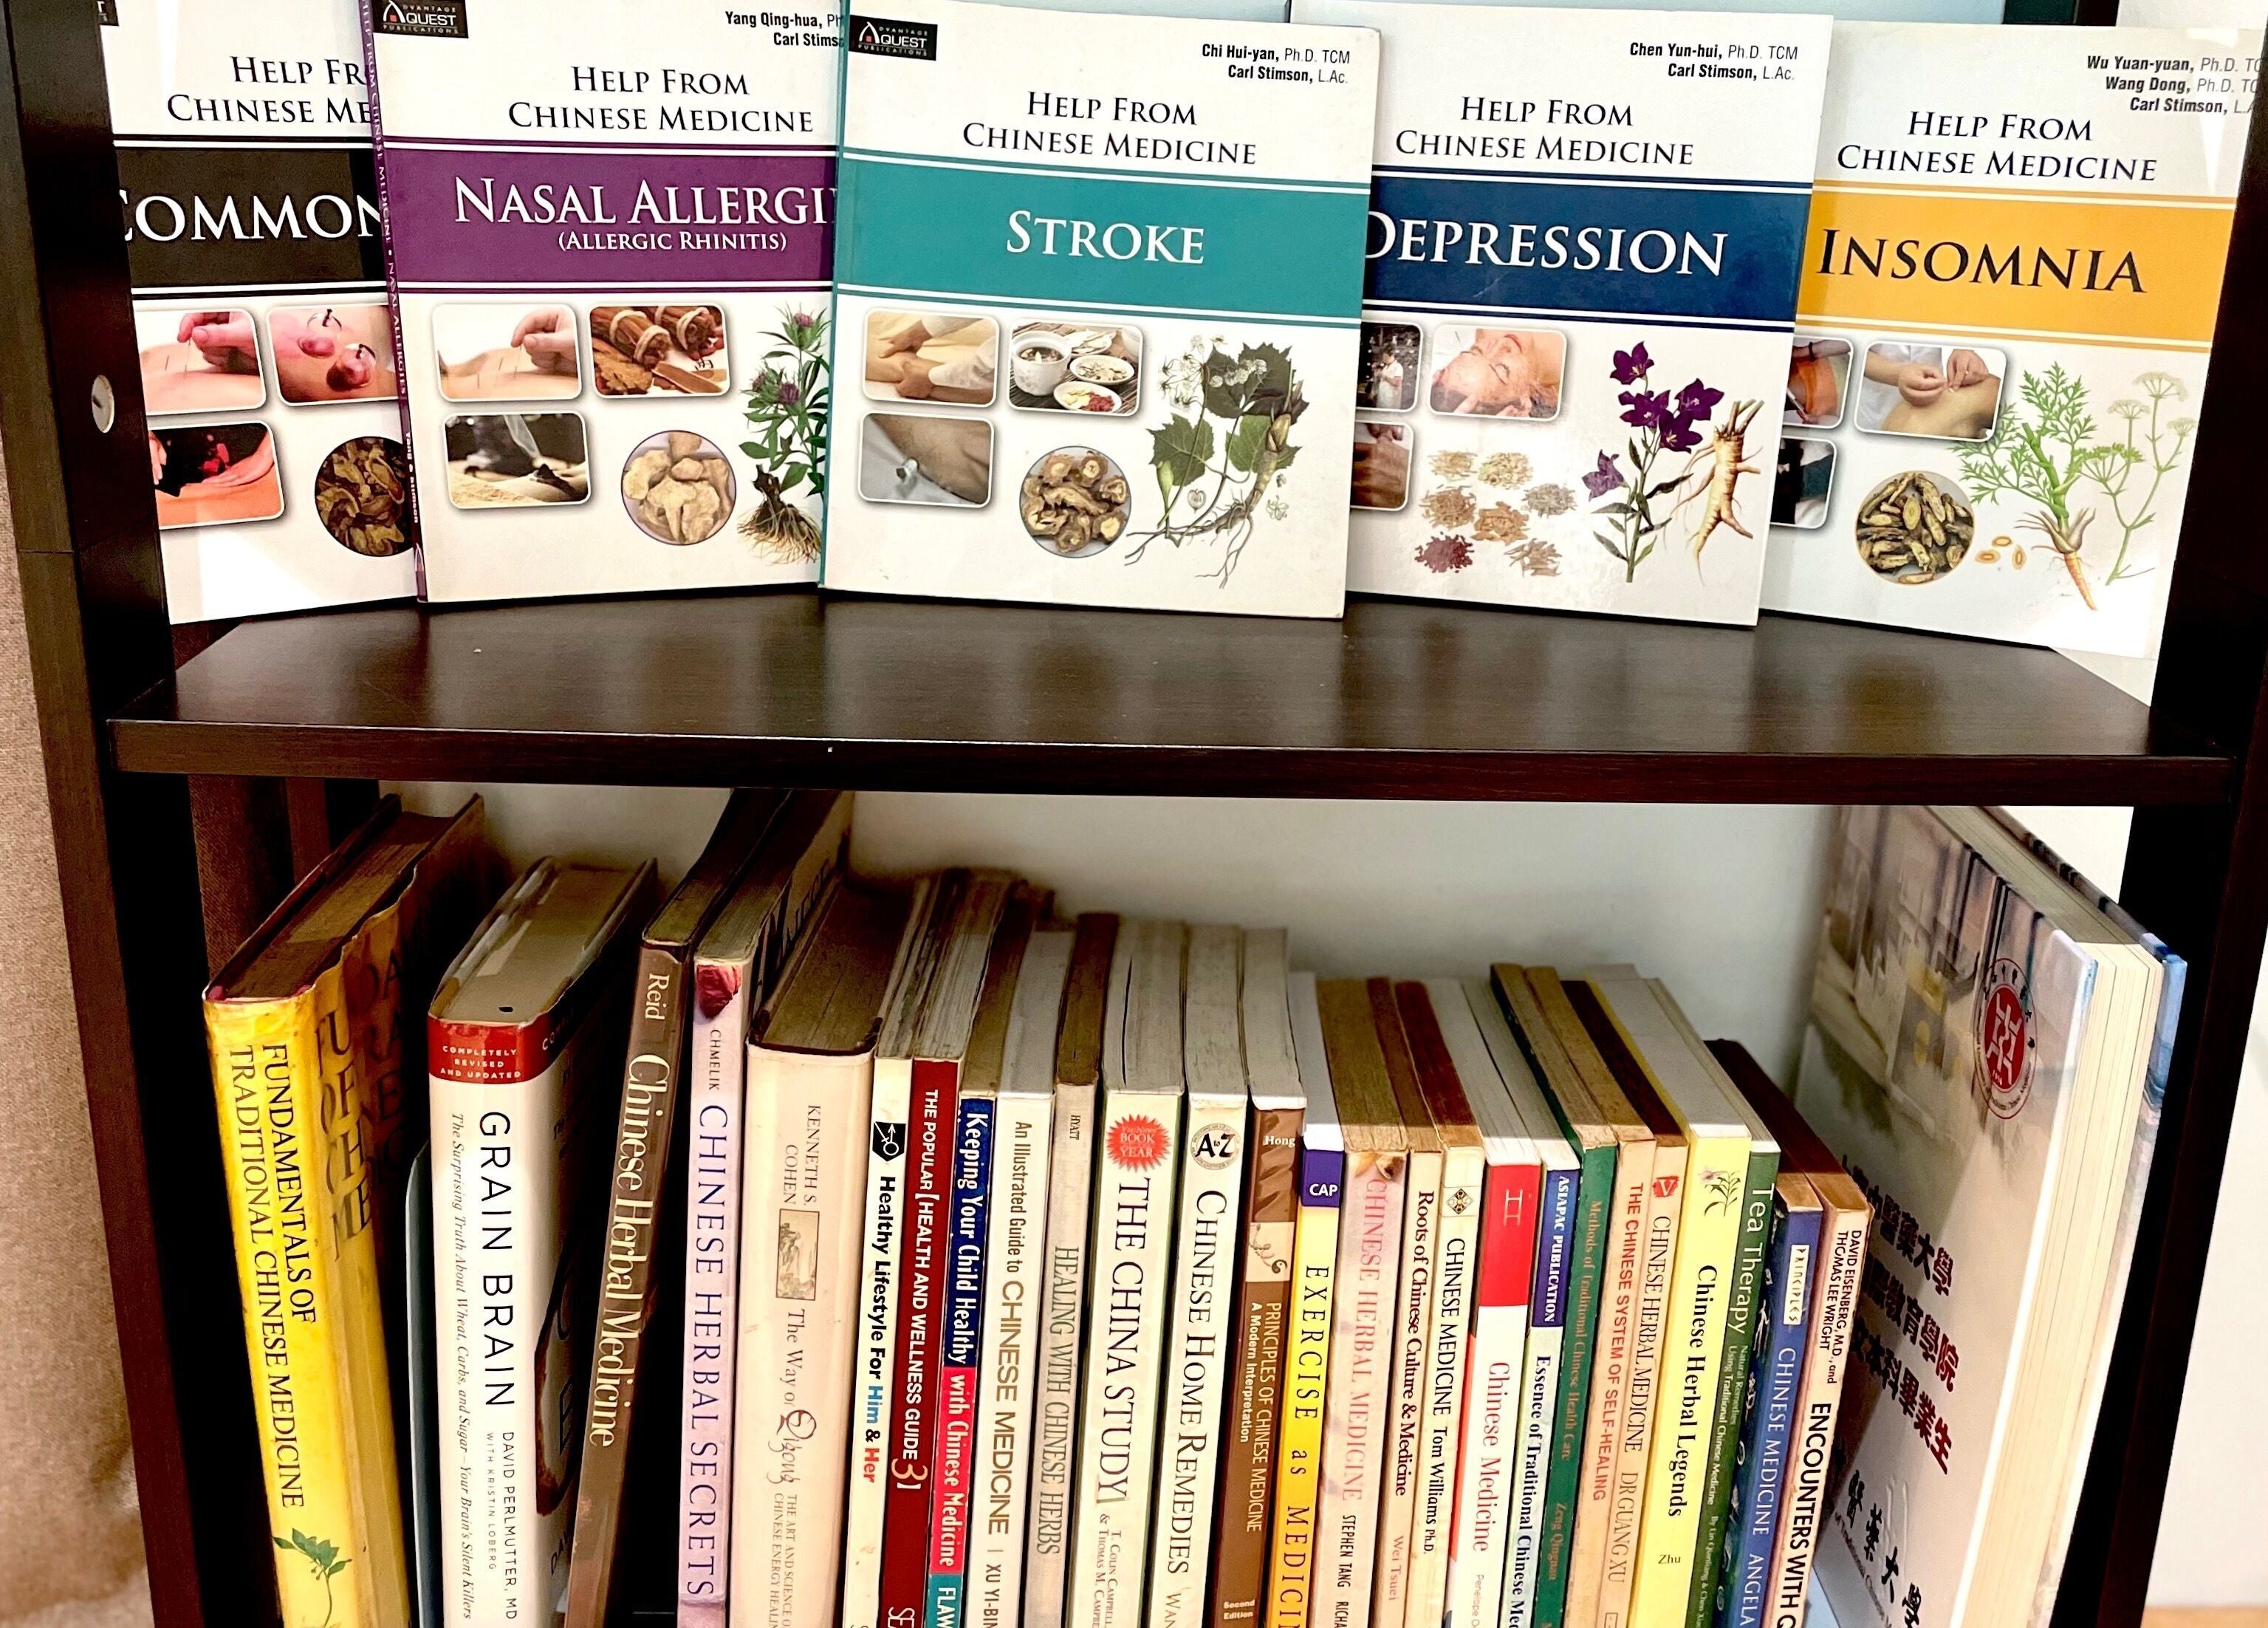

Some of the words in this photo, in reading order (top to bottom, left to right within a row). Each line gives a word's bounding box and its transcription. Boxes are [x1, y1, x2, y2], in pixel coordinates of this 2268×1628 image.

[405, 13, 456, 26] QUEST
[880, 34, 927, 48] QUEST
[570, 66, 651, 94] HELP
[661, 69, 750, 95] FROM
[1202, 44, 1222, 58] Chi
[1227, 45, 1279, 63] Hui-yan,
[1284, 47, 1318, 63] Ph.D.
[1322, 49, 1350, 64] TCM
[1228, 65, 1254, 79] Carl
[1258, 66, 1312, 84] Stimson,
[1318, 69, 1348, 83] L.Ac.
[2086, 55, 2109, 69] Wu
[2114, 55, 2194, 73] Yuan-yuan,
[2199, 57, 2238, 73] Ph.D.
[508, 102, 648, 131] CHINESE
[659, 106, 813, 132] MEDICINE
[1027, 92, 1102, 118] HELP
[1112, 98, 1197, 126] FROM
[1907, 111, 1989, 138] HELP
[1998, 114, 2092, 141] FROM
[963, 122, 1093, 155] CHINESE
[1103, 132, 1257, 165] MEDICINE
[1837, 145, 1974, 174] CHINESE
[1984, 150, 2158, 181] MEDICINE
[124, 190, 382, 242] OMMON
[454, 176, 617, 223] NASAL
[627, 179, 838, 225] ALLERGI
[558, 230, 673, 250] (ALLERGIC
[679, 233, 787, 251] RHINITIS)
[1006, 209, 1205, 264] STROKE
[1366, 211, 1729, 277] DEPRESSION
[1816, 228, 2148, 294] INSOMNIA
[645, 974, 670, 1020] Reid
[440, 1067, 462, 1078] AND
[467, 1070, 521, 1079] UPDATED
[442, 1045, 516, 1056] COMPLETELY
[454, 1058, 504, 1068] REVISED
[708, 1029, 722, 1090] CHMELIK
[616, 1054, 671, 1191] Chinese
[924, 1090, 938, 1118] THE
[1015, 1121, 1032, 1138] An
[1070, 1115, 1081, 1140] HYATT
[230, 1044, 273, 1244] TRADITIONAL
[920, 1121, 936, 1191] POPULAR
[957, 1113, 988, 1190] Keeping
[1120, 1133, 1155, 1143] BOOK
[1120, 1147, 1153, 1157] YEAR
[1264, 1135, 1296, 1148] Hong
[262, 1043, 312, 1282] FUNDAMENTALS
[291, 1288, 318, 1324] OF
[479, 1112, 513, 1250] GRAIN
[696, 1105, 729, 1274] CHINESE
[1010, 1143, 1031, 1214] Illustrated
[1309, 1183, 1338, 1197] CAP
[1627, 1183, 1643, 1215] THE
[1746, 1183, 1775, 1232] Tea
[871, 1176, 896, 1254] Healthy
[961, 1195, 984, 1239] Your
[1008, 1218, 1026, 1256] Guide
[1114, 1177, 1151, 1251] THE
[1360, 1179, 1388, 1282] CHINESE
[1415, 1190, 1434, 1242] Roots
[605, 1193, 654, 1299] Herbal
[958, 1245, 981, 1291] Child
[1007, 1260, 1024, 1273] to
[1188, 1191, 1227, 1324] CHINESE
[1414, 1245, 1428, 1265] of
[1617, 1220, 1639, 1290] CHINESE
[1644, 1216, 1671, 1293] CHINESE
[868, 1261, 891, 1341] Lifestyle
[913, 1272, 930, 1309] AND
[1049, 1245, 1079, 1335] HEALING
[1408, 1268, 1428, 1335] Chinese
[1441, 1237, 1465, 1317] CHINESE
[1690, 1265, 1718, 1349] Chinese
[1728, 1242, 1763, 1334] Therapy
[255, 1251, 289, 1369] CHINESE
[482, 1274, 515, 1406] BRAIN
[948, 1297, 976, 1364] Healthy
[1106, 1261, 1144, 1377] CHINA
[1351, 1291, 1379, 1383] HERBAL
[1610, 1295, 1631, 1359] SYSTEM
[1636, 1297, 1661, 1359] HERBAL
[691, 1293, 722, 1429] HERBAL
[869, 1347, 885, 1380] For
[905, 1313, 927, 1403] WELLNESS
[996, 1280, 1024, 1402] CHINESE
[1046, 1342, 1073, 1395] WITH
[1258, 1302, 1283, 1384] PRINCIPLES
[1294, 1265, 1329, 1420] EXERCISE
[1402, 1338, 1422, 1400] Culture
[1433, 1323, 1459, 1416] MEDICINE
[589, 1308, 643, 1447] Medicine
[867, 1385, 883, 1424] Him
[949, 1374, 970, 1415] with
[1179, 1333, 1216, 1426] HOME
[1258, 1386, 1274, 1405] OF
[1483, 1362, 1510, 1446] Chinese
[1530, 1355, 1551, 1420] Essence
[1605, 1364, 1622, 1386] OF
[1679, 1355, 1707, 1426] Herbal
[1767, 1347, 1797, 1432] CHINESE
[866, 1429, 880, 1442] &
[902, 1409, 920, 1460] GUIDE
[1254, 1409, 1272, 1465] CHINESE
[1402, 1403, 1417, 1420] &
[1529, 1424, 1543, 1440] of
[1624, 1367, 1653, 1454] MEDICINE
[268, 1374, 305, 1510] MEDICINE
[503, 1432, 515, 1479] DAVID
[863, 1447, 880, 1483] Her
[945, 1420, 969, 1488] Chinese
[1041, 1402, 1069, 1484] CHINESE
[1097, 1385, 1135, 1498] STUDY
[1291, 1449, 1307, 1475] as
[1342, 1391, 1371, 1501] MEDICINE
[1395, 1422, 1416, 1497] Medicine
[1431, 1426, 1448, 1458] Tom
[1592, 1389, 1618, 1501] SELF-HEALING
[487, 1468, 496, 1517] KRISTIN
[989, 1412, 1016, 1536] MEDICINE
[1168, 1433, 1207, 1575] REMEDIES
[1247, 1467, 1267, 1533] MEDICINE
[1426, 1462, 1446, 1525] Williams
[1473, 1457, 1501, 1552] Medicine
[1518, 1444, 1542, 1530] Traditional
[1619, 1471, 1638, 1494] DR
[1668, 1434, 1696, 1517] Legends
[1753, 1439, 1781, 1536] MEDICINE
[1789, 1403, 1832, 1550] ENCOUNTERS
[487, 1523, 497, 1570] LOBERG
[503, 1486, 518, 1592] PERLMUTTER,
[687, 1442, 719, 1595] SECRETS
[939, 1492, 965, 1567] Medicine
[1037, 1493, 1063, 1554] HERBS
[1339, 1514, 1357, 1558] STEPHEN
[1423, 1528, 1435, 1554] Ph.D.
[1612, 1497, 1636, 1556] GUANG
[1337, 1562, 1351, 1588] TANG
[1512, 1535, 1532, 1596] Chinese
[1608, 1560, 1628, 1583] XU
[1657, 1554, 1681, 1564] Zhu
[1740, 1553, 1761, 1626] ANGELA
[1781, 1553, 1808, 1609] WITH
[505, 1598, 517, 1620] MD
[1223, 1599, 1255, 1610] Second
[1224, 1610, 1253, 1621] Edition
